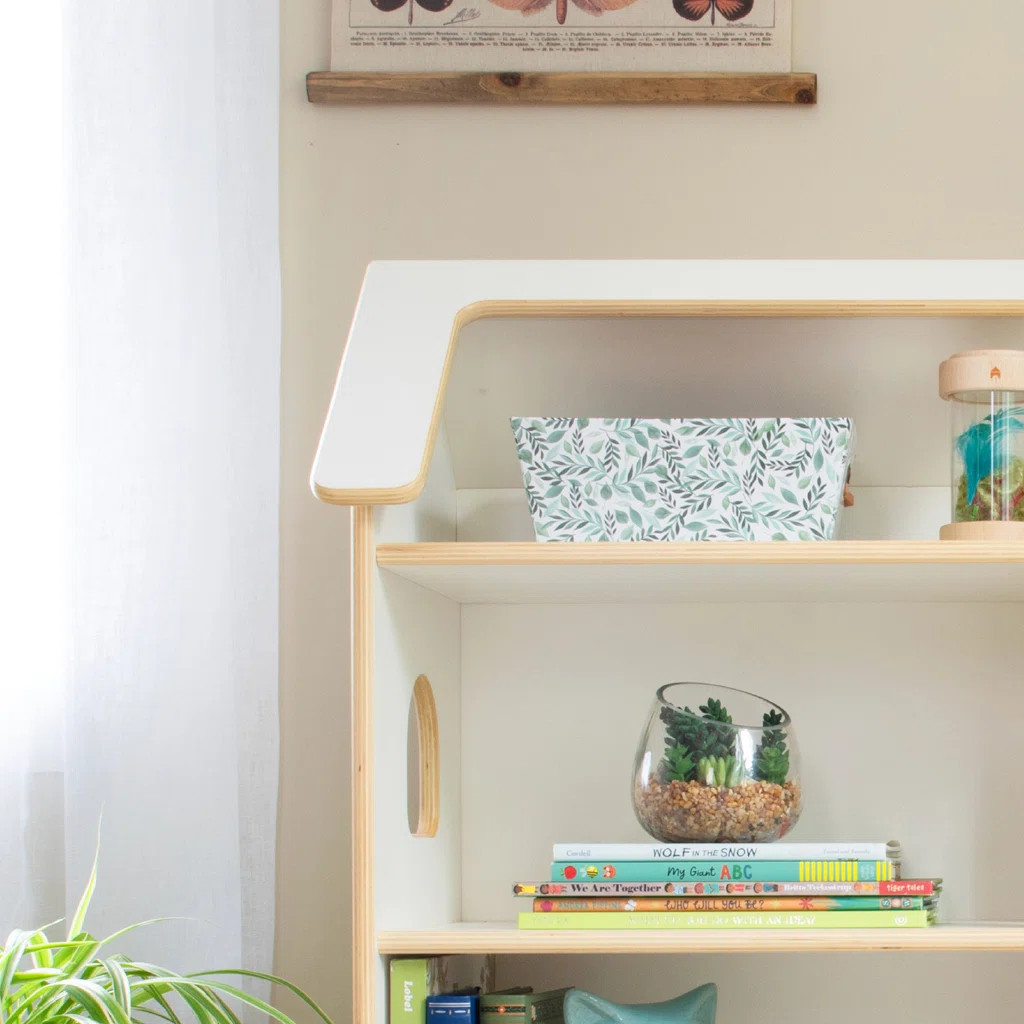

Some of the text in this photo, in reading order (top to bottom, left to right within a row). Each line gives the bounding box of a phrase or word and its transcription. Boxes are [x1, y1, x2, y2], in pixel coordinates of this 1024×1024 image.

[653, 847, 690, 858] WOLF
[701, 849, 719, 857] THE
[720, 847, 758, 858] SNOW
[667, 864, 753, 880] My Giant ABC
[571, 883, 662, 894] We Are Together
[886, 883, 925, 892] tiger tales
[664, 899, 689, 909] WHO
[693, 899, 718, 909] WILL
[721, 899, 741, 910] YOU
[733, 914, 762, 925] WITH
[767, 914, 782, 925] AN
[403, 980, 414, 1012] Lobel
